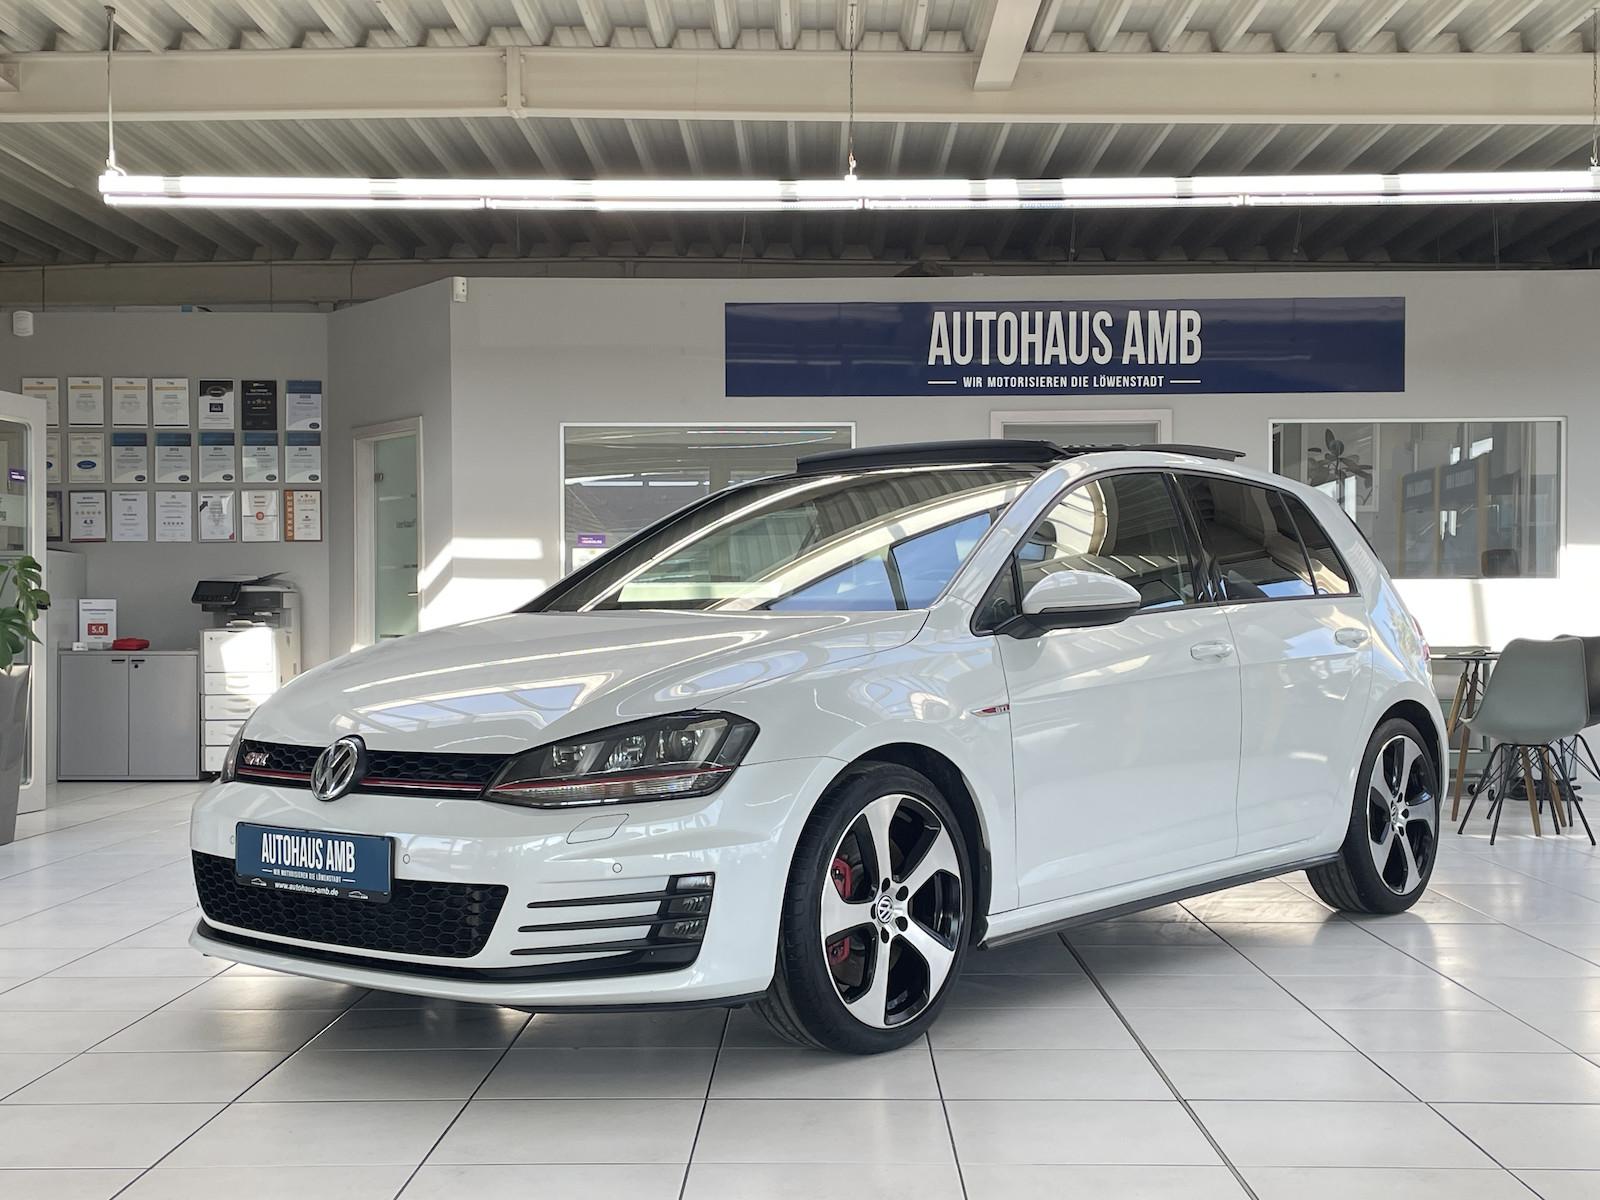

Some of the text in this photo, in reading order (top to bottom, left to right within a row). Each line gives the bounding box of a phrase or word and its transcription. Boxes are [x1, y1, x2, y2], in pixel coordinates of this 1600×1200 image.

[927, 310, 1202, 366] AUTOHAUS AMB
[962, 372, 1166, 389] WIR MOTORISIEREN DIE LÖWENSTADT
[261, 832, 356, 873] AUTOHAUS AMB
[274, 881, 339, 897] www.autohaus-amb.de
